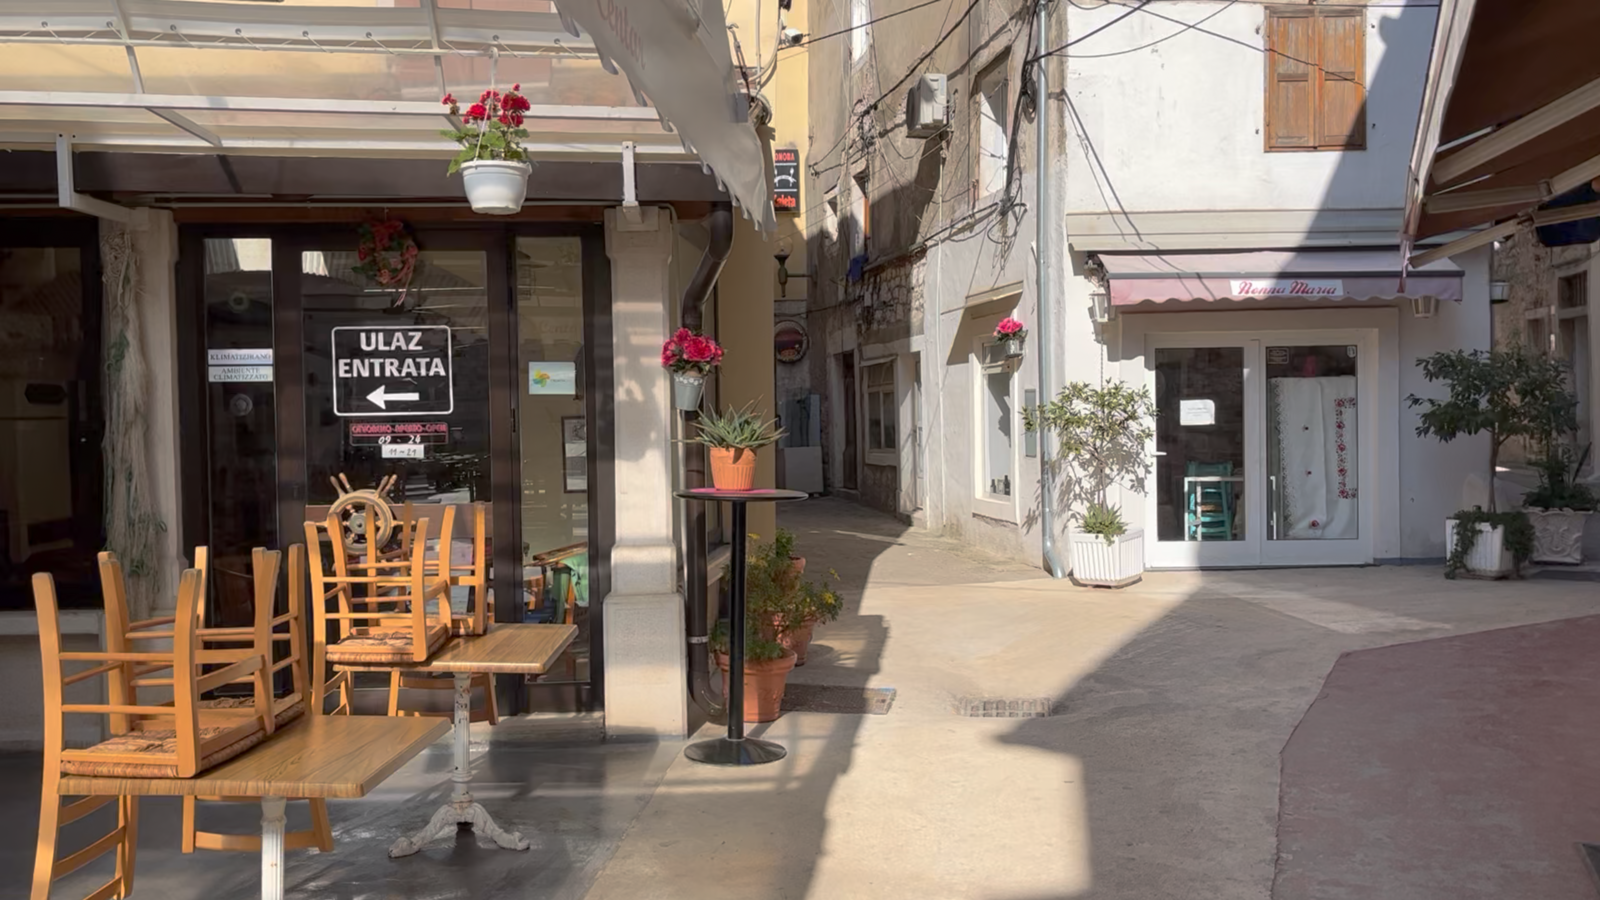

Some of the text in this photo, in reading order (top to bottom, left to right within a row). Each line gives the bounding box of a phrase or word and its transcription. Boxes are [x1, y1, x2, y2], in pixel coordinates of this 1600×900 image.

[775, 152, 796, 161] ONOBA
[1238, 280, 1337, 295] Nonna Maria
[360, 331, 423, 351] ULAZ
[338, 358, 447, 378] ENTRATA
